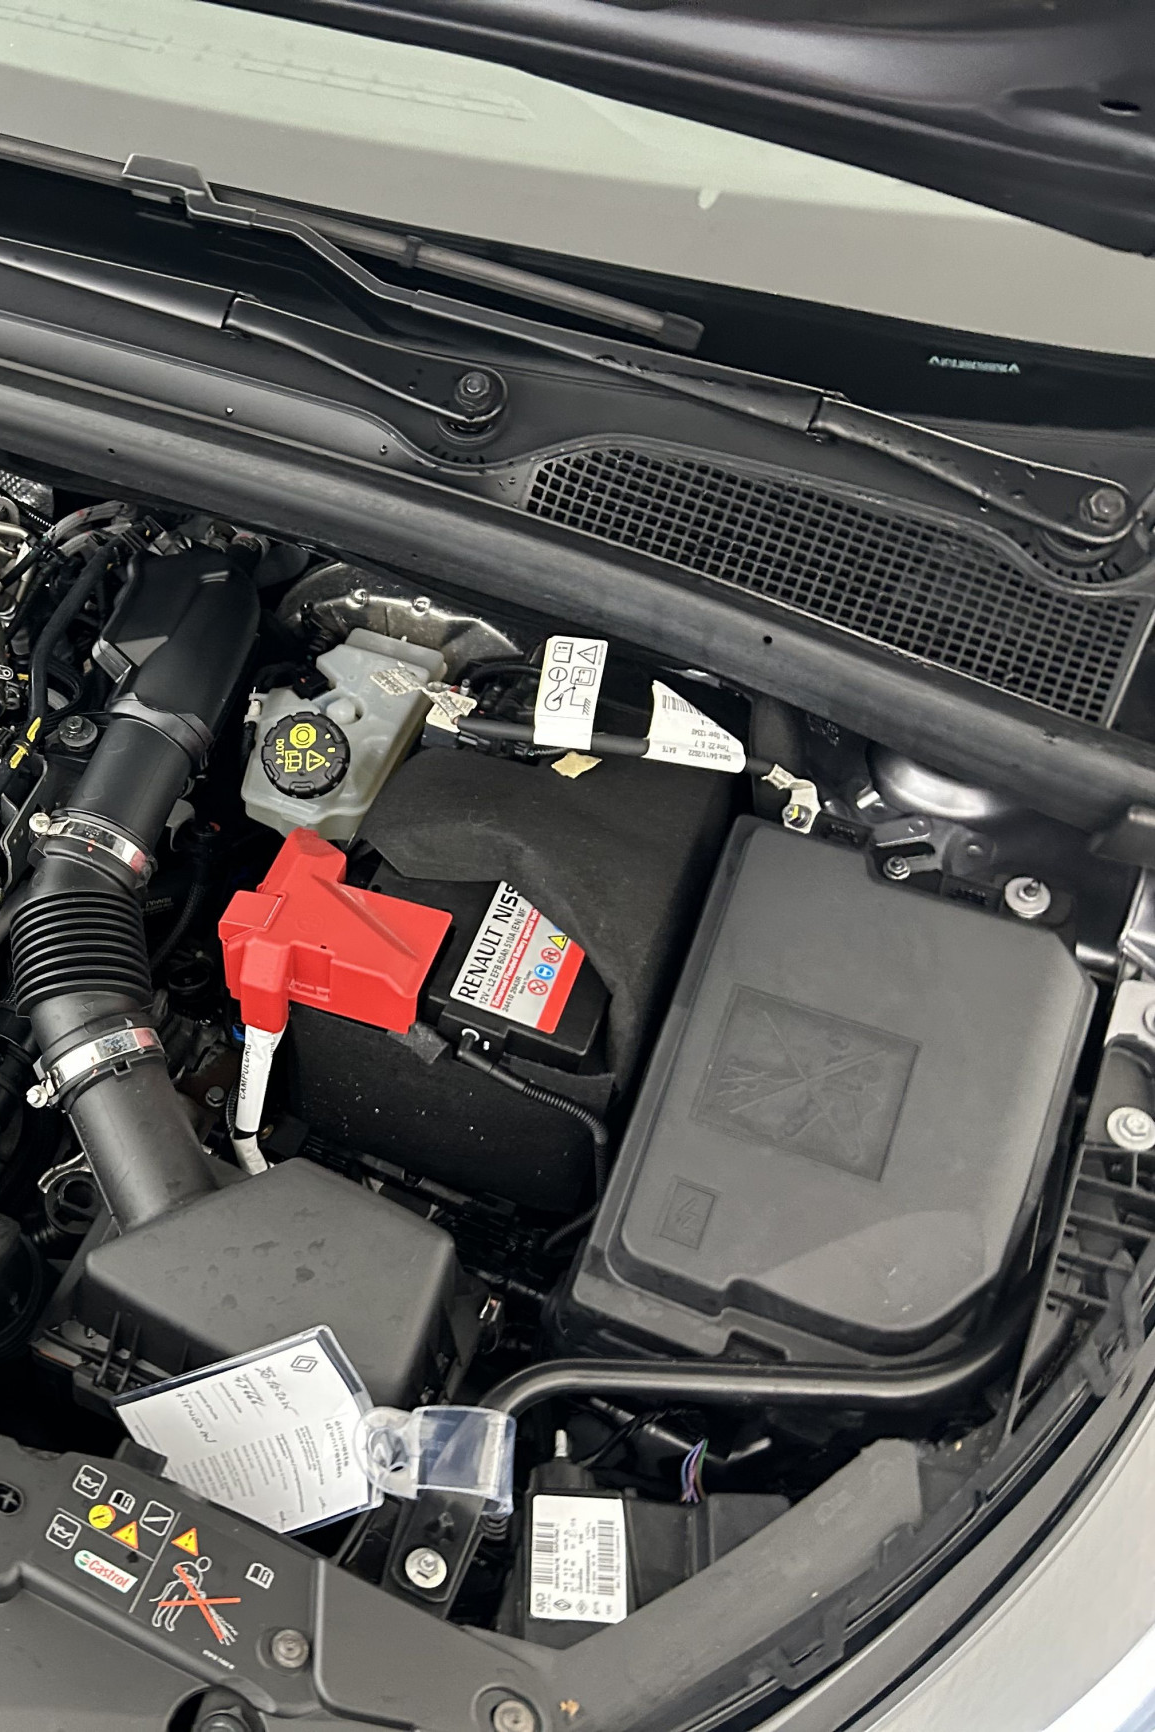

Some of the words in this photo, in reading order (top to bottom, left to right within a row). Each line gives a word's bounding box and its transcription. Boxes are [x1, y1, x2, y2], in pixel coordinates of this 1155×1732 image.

[275, 738, 284, 755] DOT
[457, 925, 504, 999] RENAULT
[491, 963, 502, 978] EFB
[88, 1559, 130, 1588] Castrol
